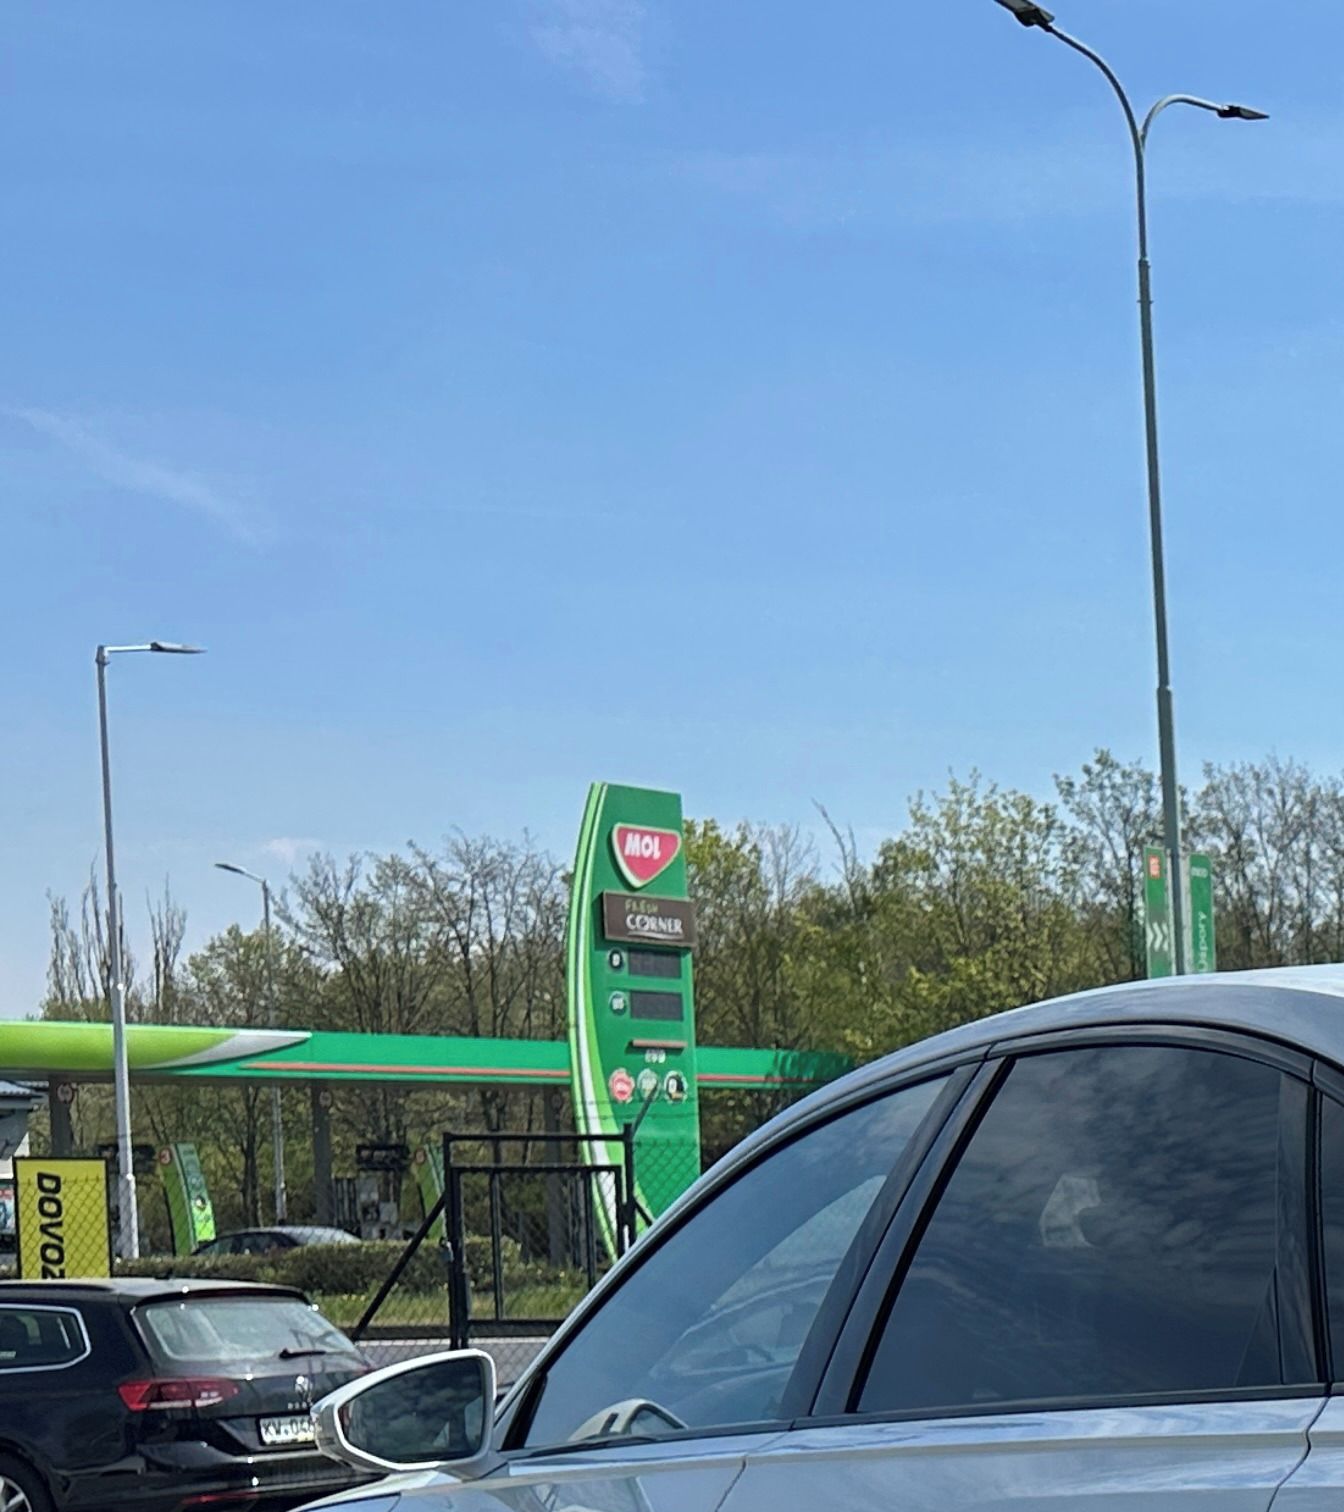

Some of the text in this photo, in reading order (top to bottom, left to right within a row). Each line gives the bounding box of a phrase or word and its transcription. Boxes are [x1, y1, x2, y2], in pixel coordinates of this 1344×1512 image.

[624, 832, 661, 860] MOL
[625, 913, 683, 934] CORNER
[37, 1171, 65, 1279] DOVOZ
